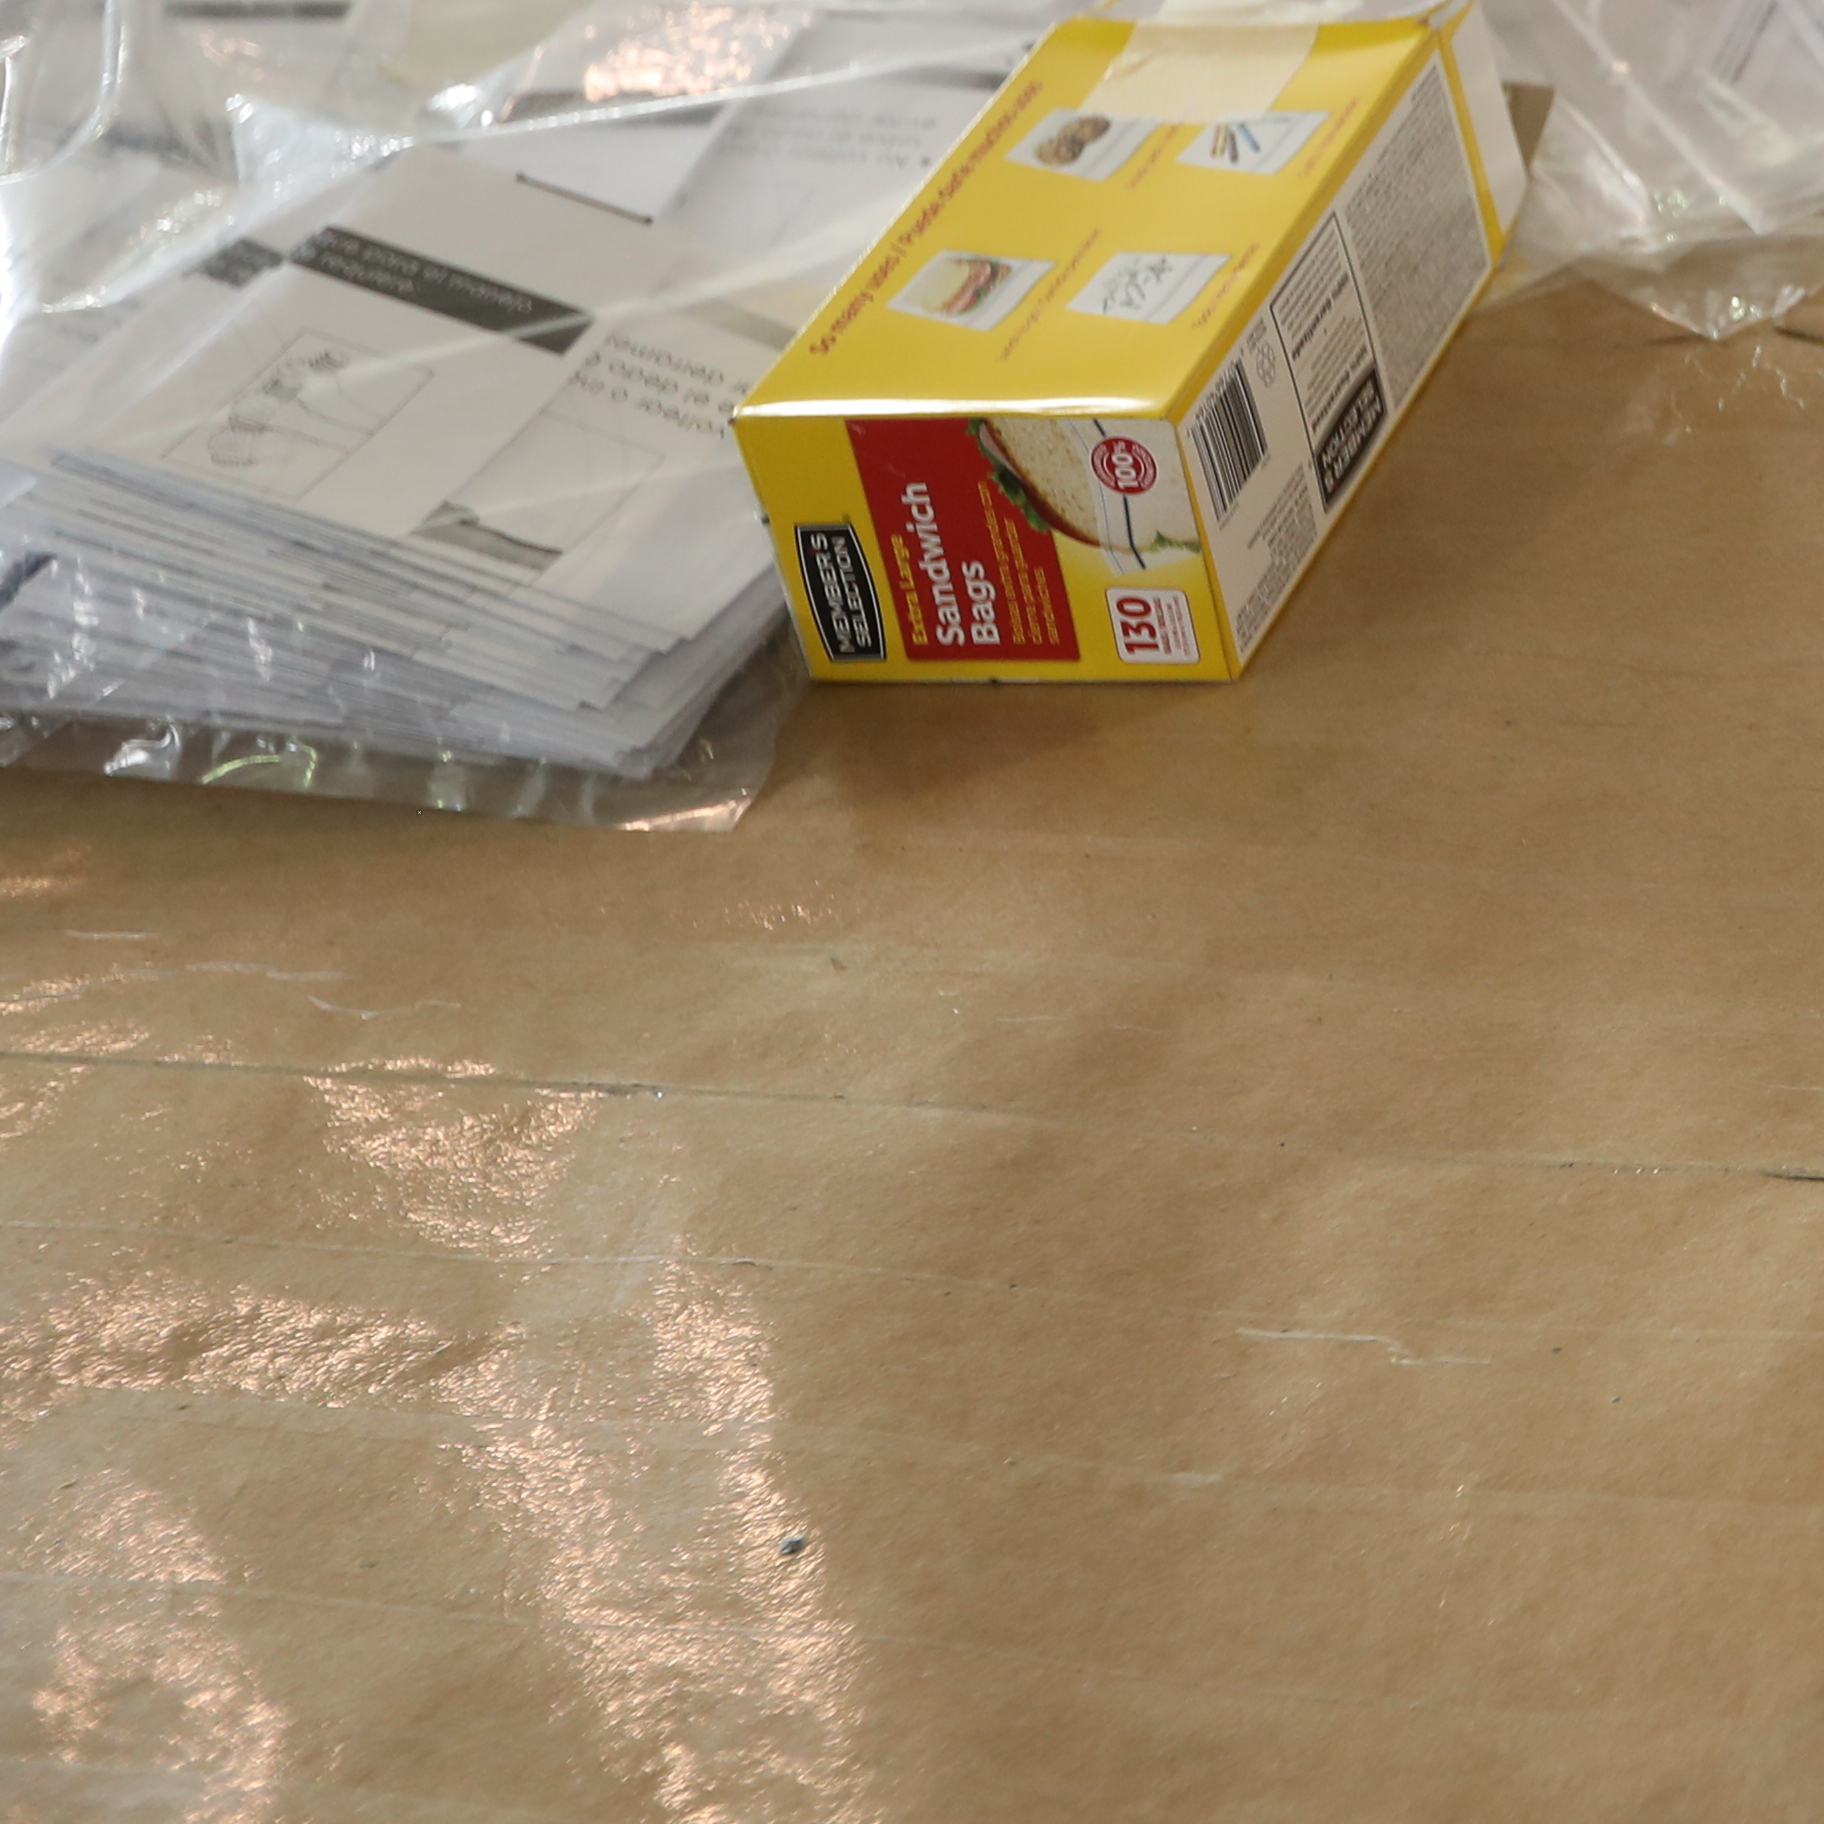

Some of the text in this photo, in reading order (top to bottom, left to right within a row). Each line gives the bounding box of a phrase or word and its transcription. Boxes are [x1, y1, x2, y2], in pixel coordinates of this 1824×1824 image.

[810, 532, 855, 653] MEMBER'S
[830, 536, 872, 648] SELECTION
[890, 534, 928, 645] Extra Large
[902, 481, 966, 647] Sandwich
[961, 560, 1000, 645] Bags
[1115, 597, 1160, 655] 130
